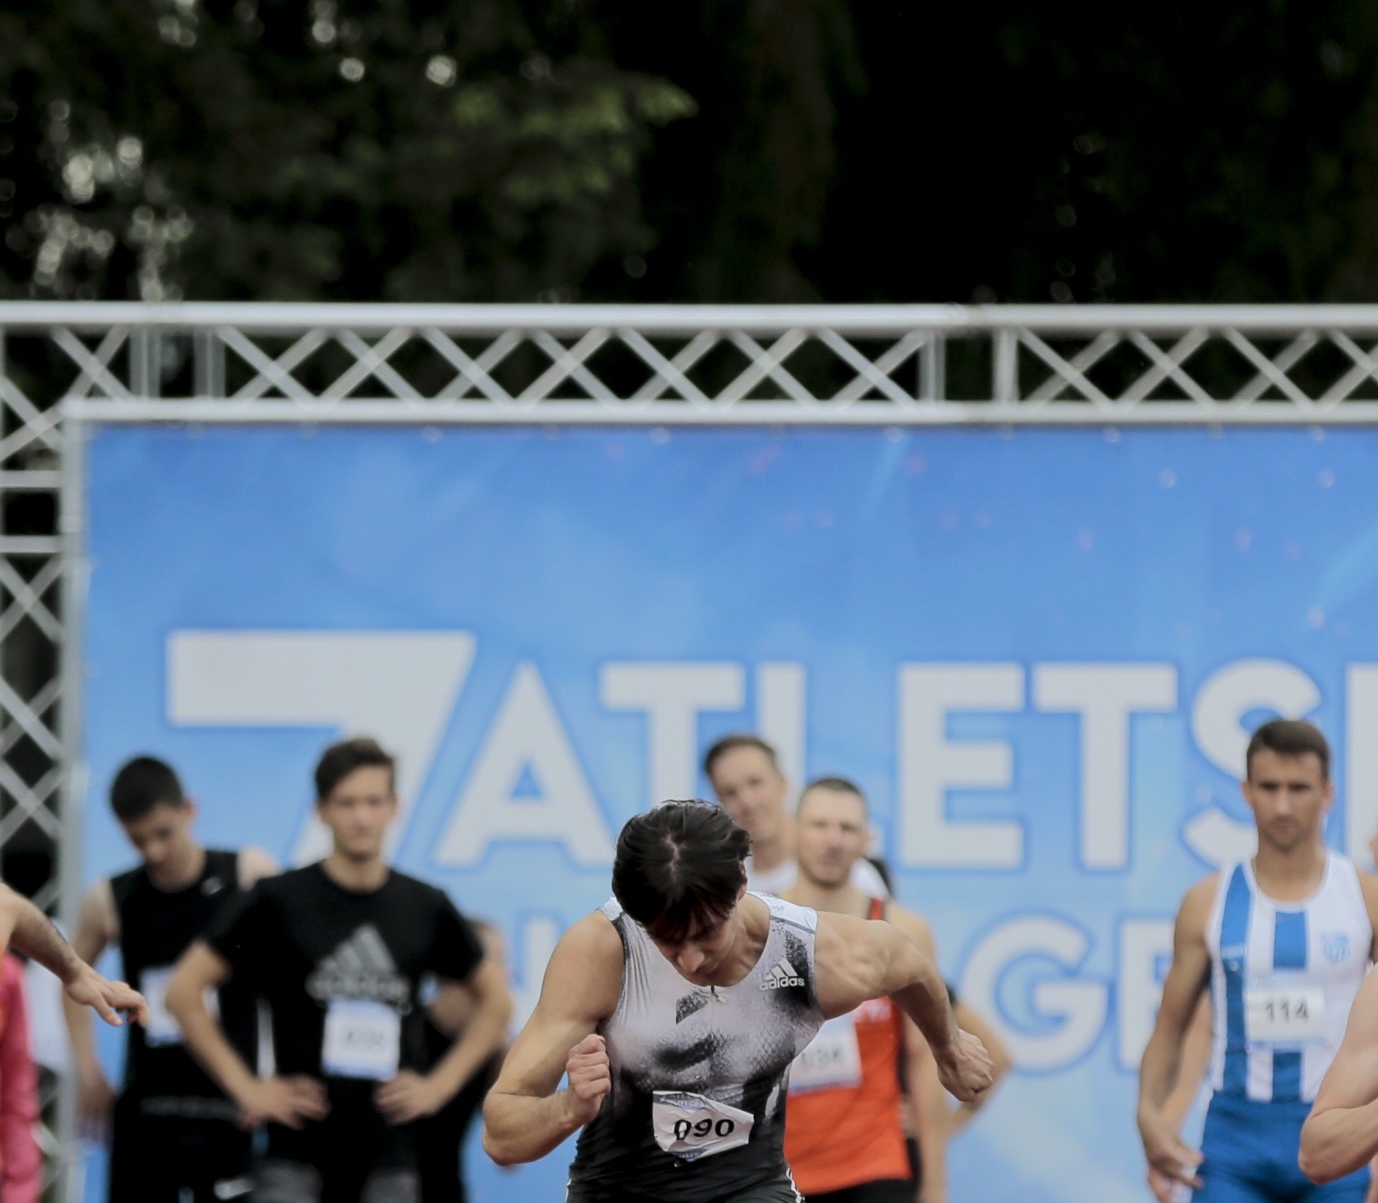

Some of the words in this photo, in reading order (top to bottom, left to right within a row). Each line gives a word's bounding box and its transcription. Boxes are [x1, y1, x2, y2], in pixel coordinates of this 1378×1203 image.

[168, 631, 474, 866] 7
[759, 976, 805, 991] adidas
[1265, 1001, 1309, 1021] 114
[673, 1118, 735, 1141] 090
